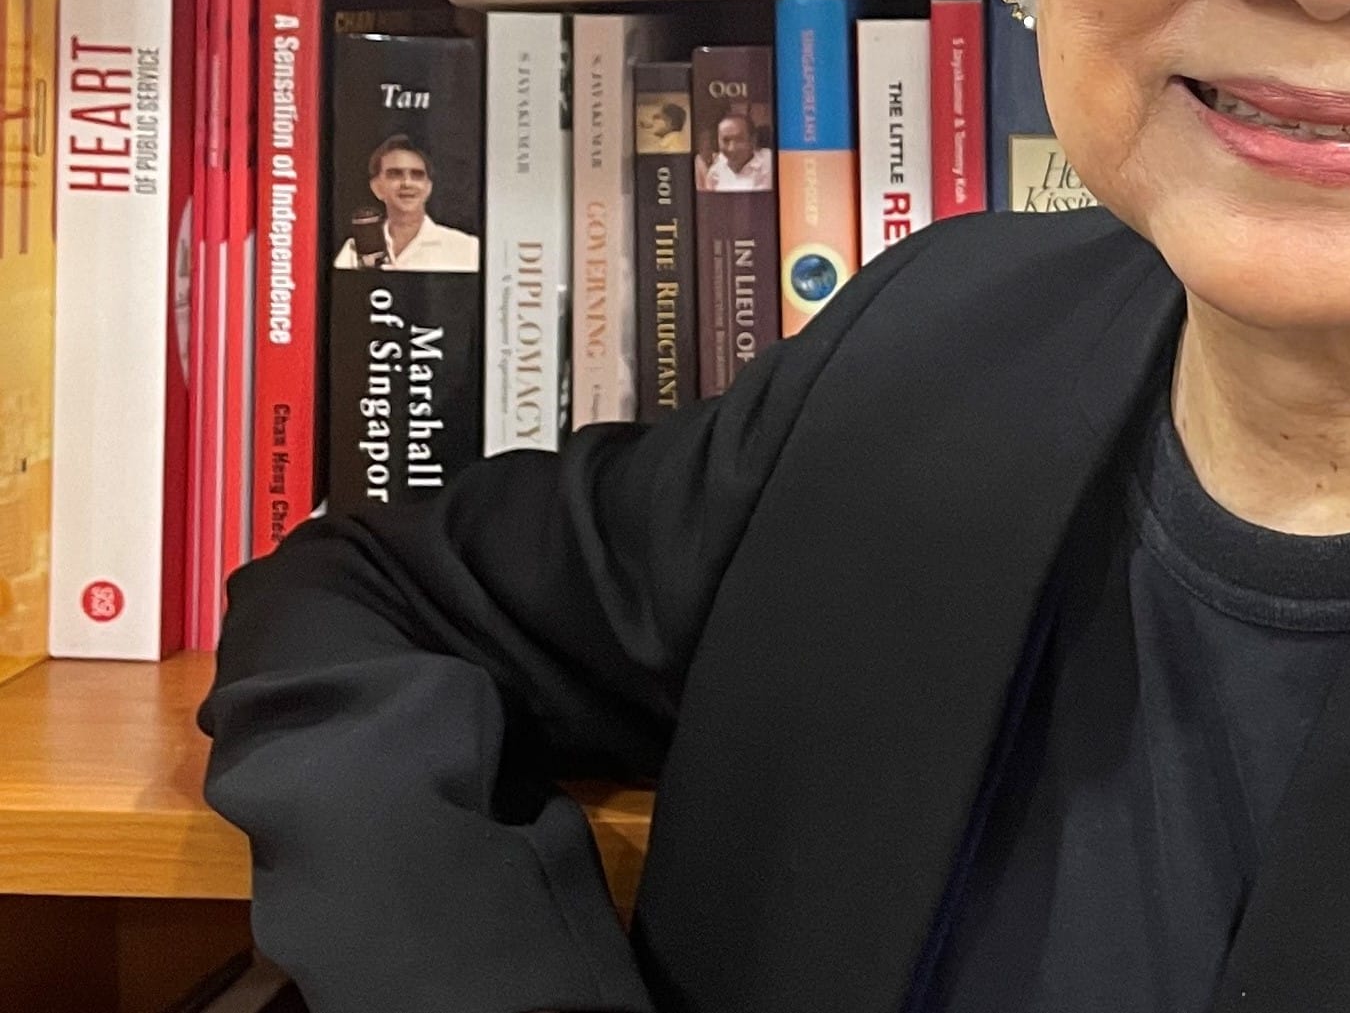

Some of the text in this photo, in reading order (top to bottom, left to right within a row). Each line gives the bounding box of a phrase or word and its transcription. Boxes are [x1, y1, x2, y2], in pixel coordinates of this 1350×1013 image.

[69, 36, 133, 193] HEART
[135, 47, 160, 195] OF PUBLIC SERVICE
[381, 83, 431, 110] Tan
[516, 66, 531, 174] JAYAKUMAR
[591, 71, 603, 170] JAYAKUMAR
[708, 80, 748, 100] OOI
[888, 81, 905, 184] THE LITTLE
[269, 14, 300, 345] A Sensation of Independence
[952, 131, 967, 175] Tommy
[954, 177, 967, 203] Koh
[585, 201, 608, 358] GOVERNING
[654, 166, 680, 409] OOI THE RELUCTANT
[734, 238, 756, 268] IN
[734, 274, 756, 326] LIEU
[370, 288, 405, 325] of
[515, 241, 544, 443] DIPLOMACY
[270, 403, 291, 495] Chan Heng
[407, 325, 444, 489] Marshall
